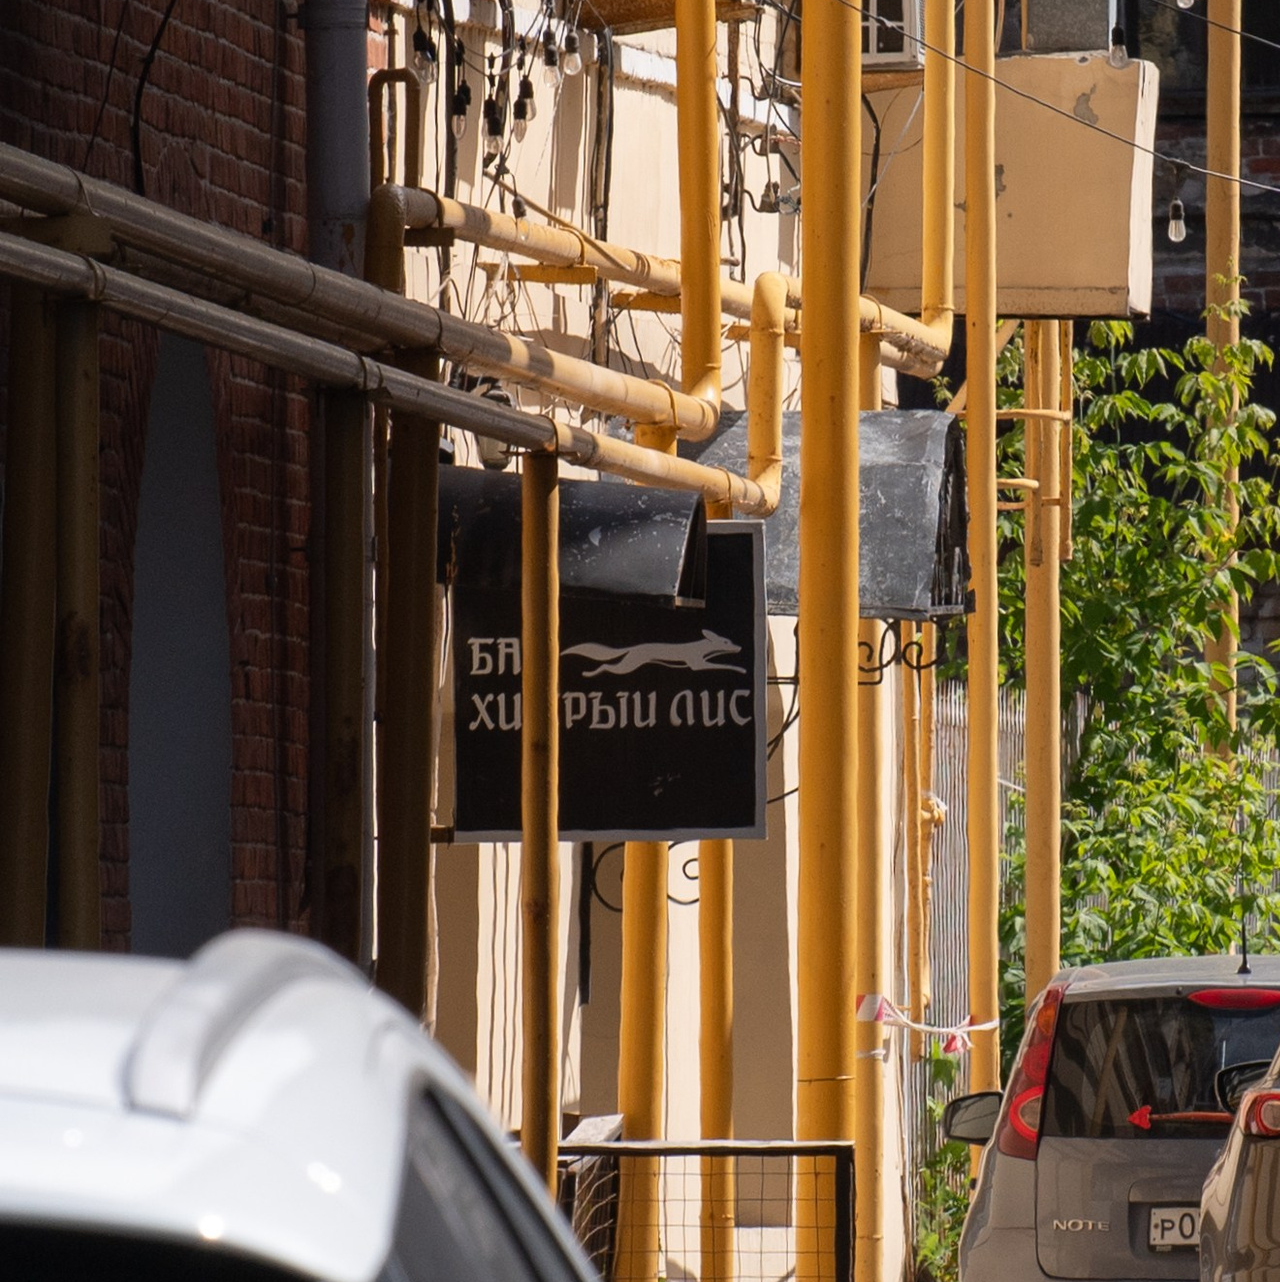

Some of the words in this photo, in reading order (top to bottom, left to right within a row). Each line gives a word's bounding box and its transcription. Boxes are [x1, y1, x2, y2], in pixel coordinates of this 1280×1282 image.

[467, 636, 522, 676] БА
[669, 688, 753, 728] ЛИС
[1052, 1218, 1110, 1232] NOTE
[1160, 1211, 1197, 1241] Р0
